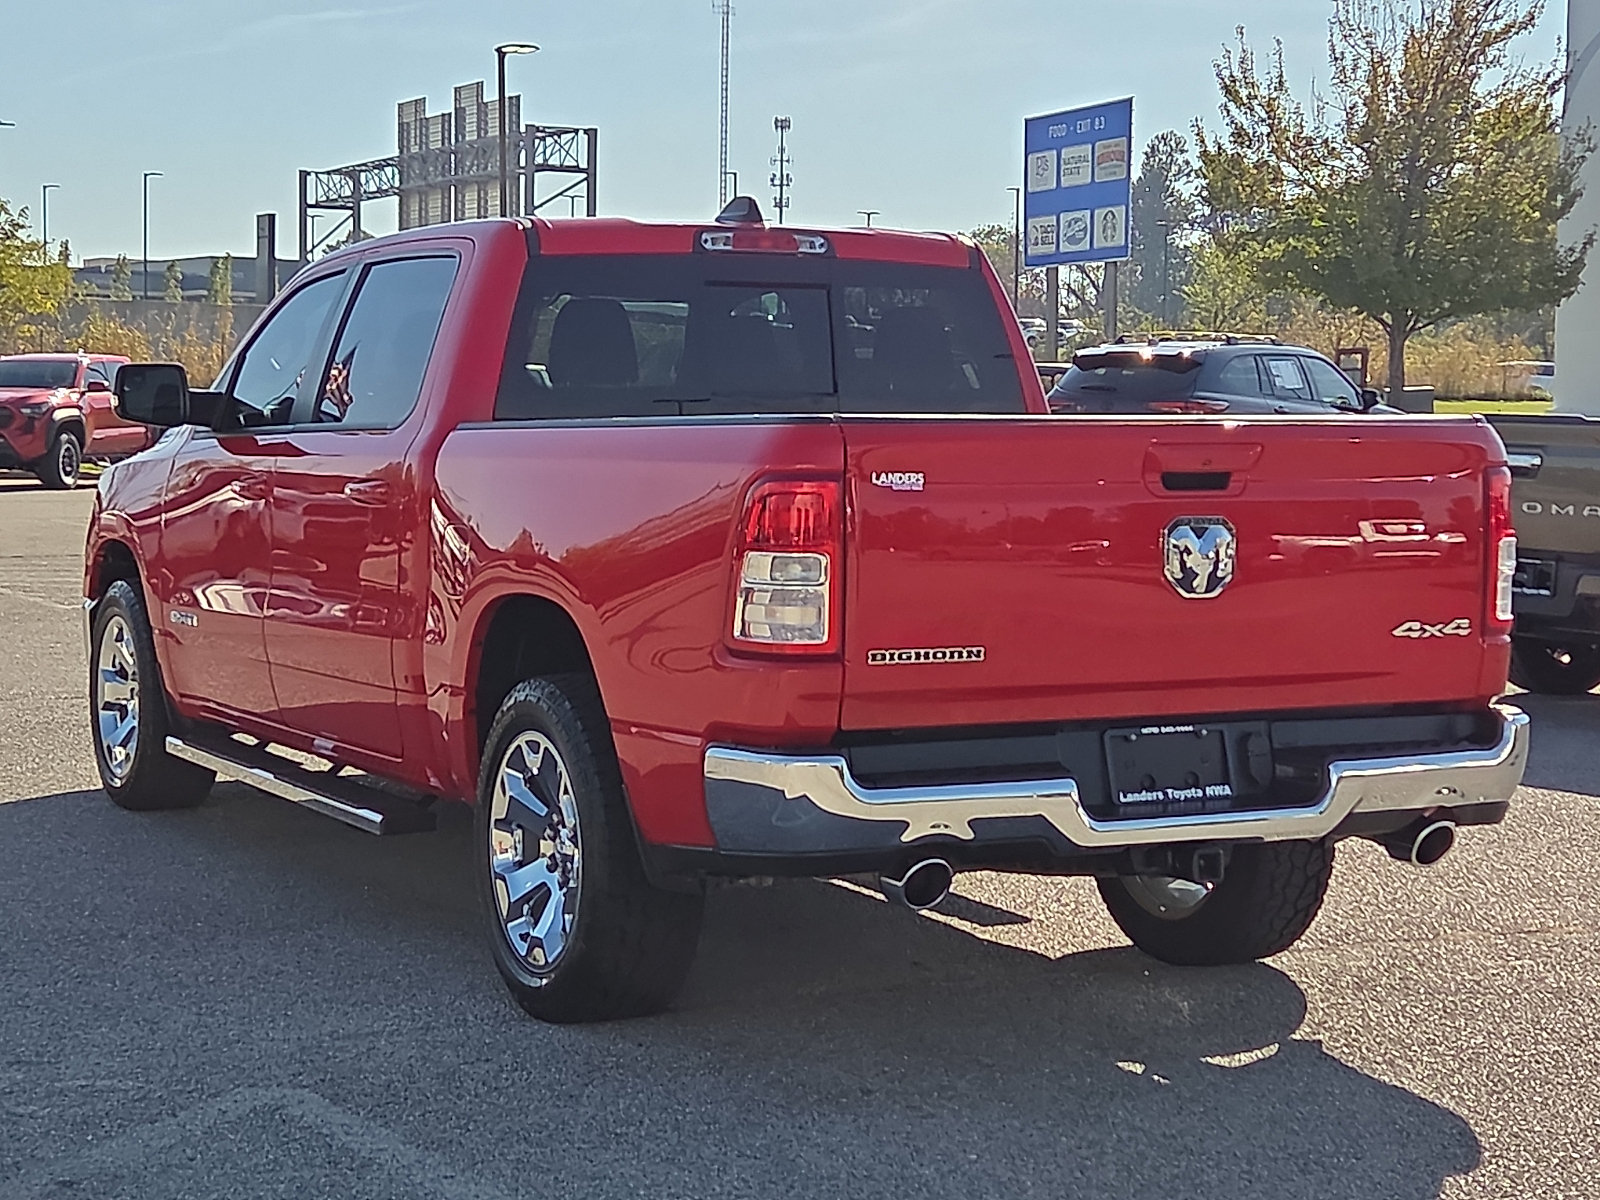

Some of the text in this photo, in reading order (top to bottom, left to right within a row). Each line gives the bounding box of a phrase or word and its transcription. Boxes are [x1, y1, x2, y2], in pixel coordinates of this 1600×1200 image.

[1049, 123, 1067, 138] FOOD
[871, 471, 925, 485] LANDERS
[1119, 790, 1165, 803] Landers
[1166, 787, 1204, 801] Toyota
